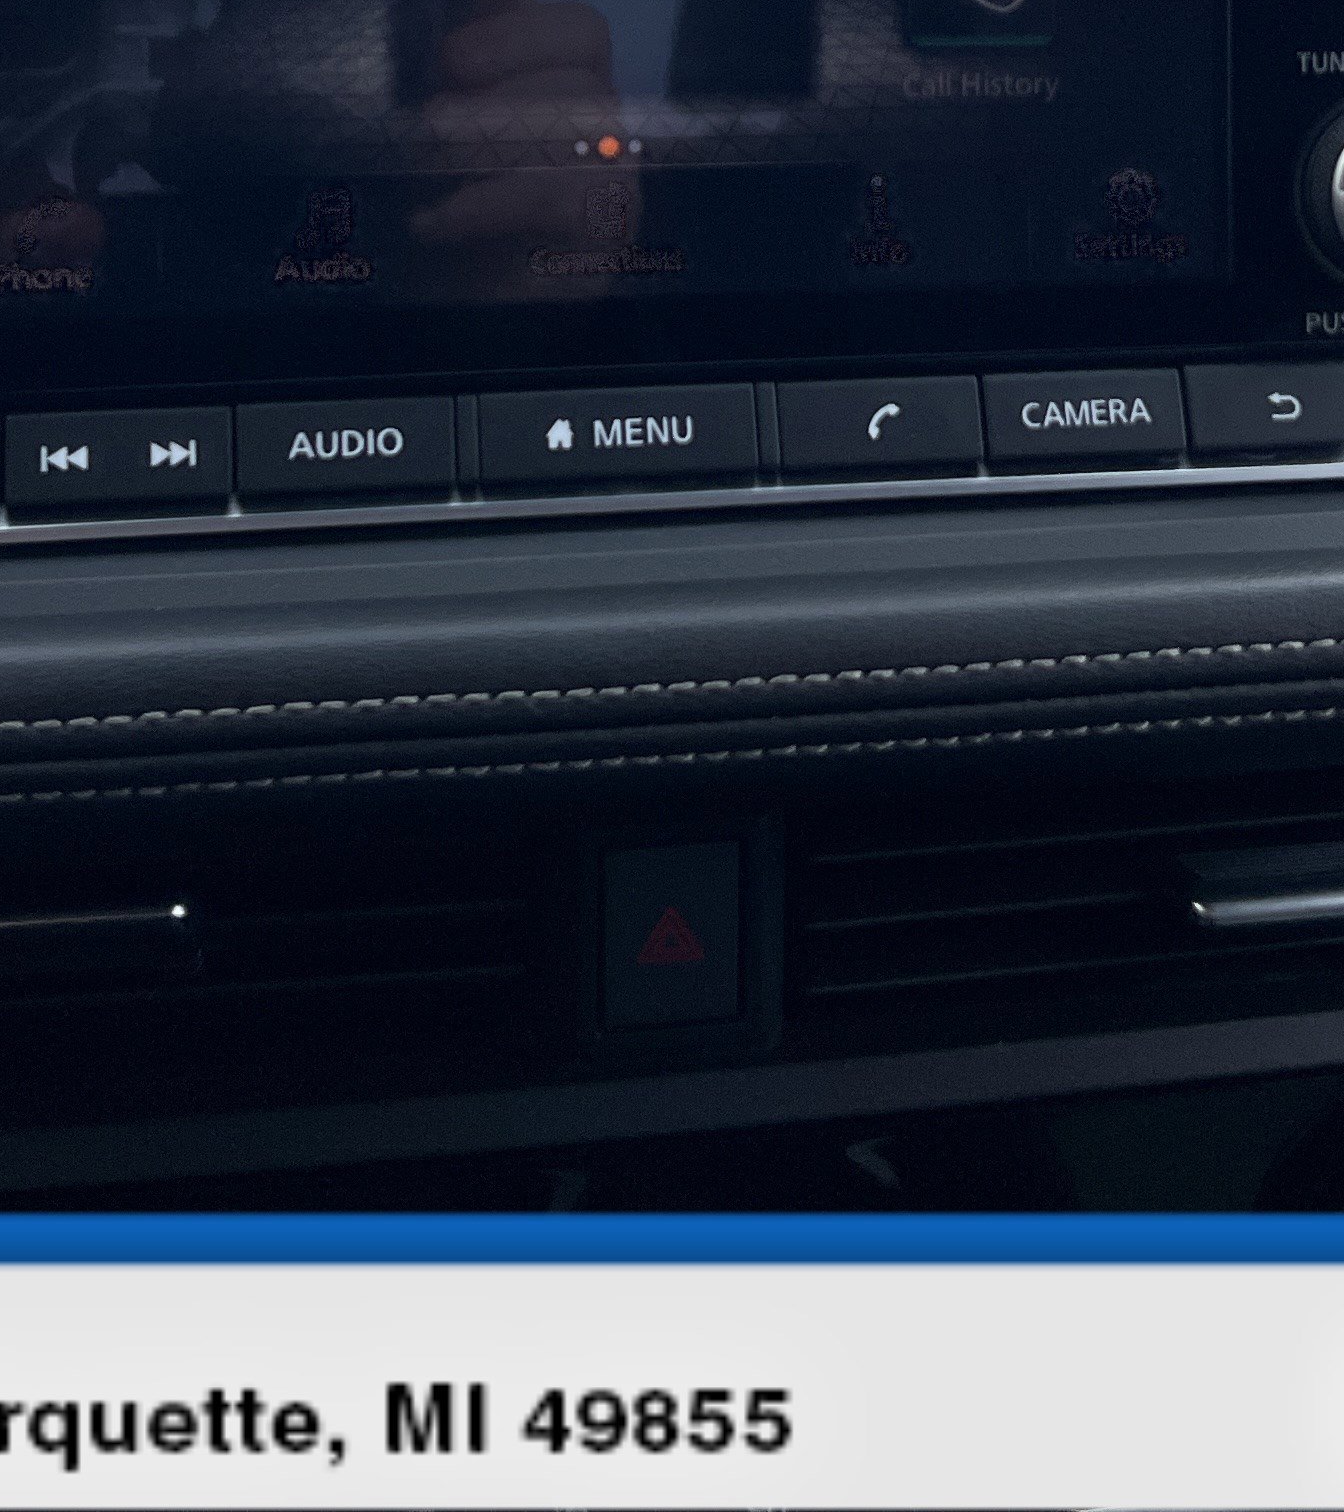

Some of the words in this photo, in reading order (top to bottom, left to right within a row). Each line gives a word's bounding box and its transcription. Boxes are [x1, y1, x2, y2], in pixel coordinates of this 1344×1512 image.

[903, 71, 951, 97] Call
[961, 71, 1058, 102] History
[1021, 396, 1151, 431] CAMERA
[288, 427, 404, 460] AUDIO
[593, 414, 695, 448] MENU
